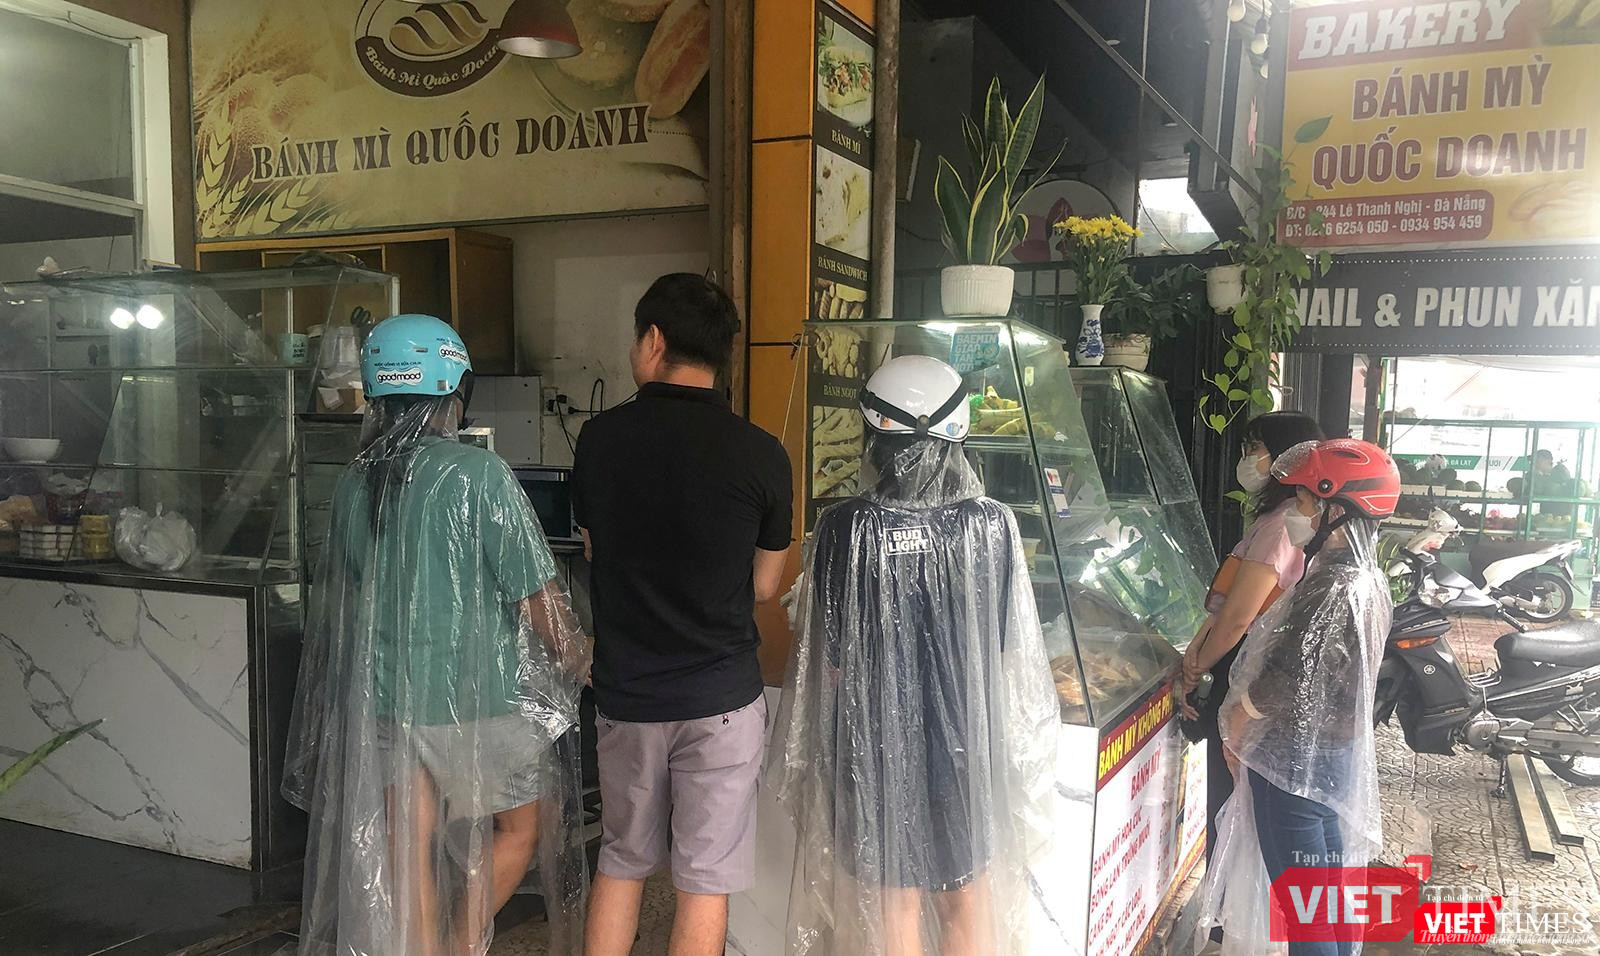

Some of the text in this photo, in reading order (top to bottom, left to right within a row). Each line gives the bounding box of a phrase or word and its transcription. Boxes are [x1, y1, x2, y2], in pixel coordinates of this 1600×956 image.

[1298, 0, 1521, 60] BAKERY
[365, 46, 397, 81] Bánh
[1353, 67, 1469, 120] BÁNH
[253, 104, 651, 182] BÁNH MÌ QUỐC DOANH
[1313, 126, 1587, 191] QUỐC DOANH
[1336, 220, 1364, 236] 6254
[1367, 219, 1389, 235] 050
[1400, 216, 1430, 232] 0934
[1433, 215, 1456, 231] 954
[1459, 214, 1482, 229] 459
[1339, 203, 1353, 218] Lê
[1356, 202, 1391, 217] Thanh
[1394, 198, 1423, 218] Nghị
[1434, 198, 1451, 213] Đà
[836, 262, 868, 282] SANDWICH
[1374, 293, 1401, 327] &
[1414, 286, 1522, 327] PHUN
[957, 333, 999, 345] BAEMIN
[377, 371, 421, 384] goodmood
[887, 538, 929, 553] LIGHT
[892, 529, 921, 542] BUD
[1098, 737, 1124, 781] BÁNH
[1130, 762, 1150, 801] BÁNH
